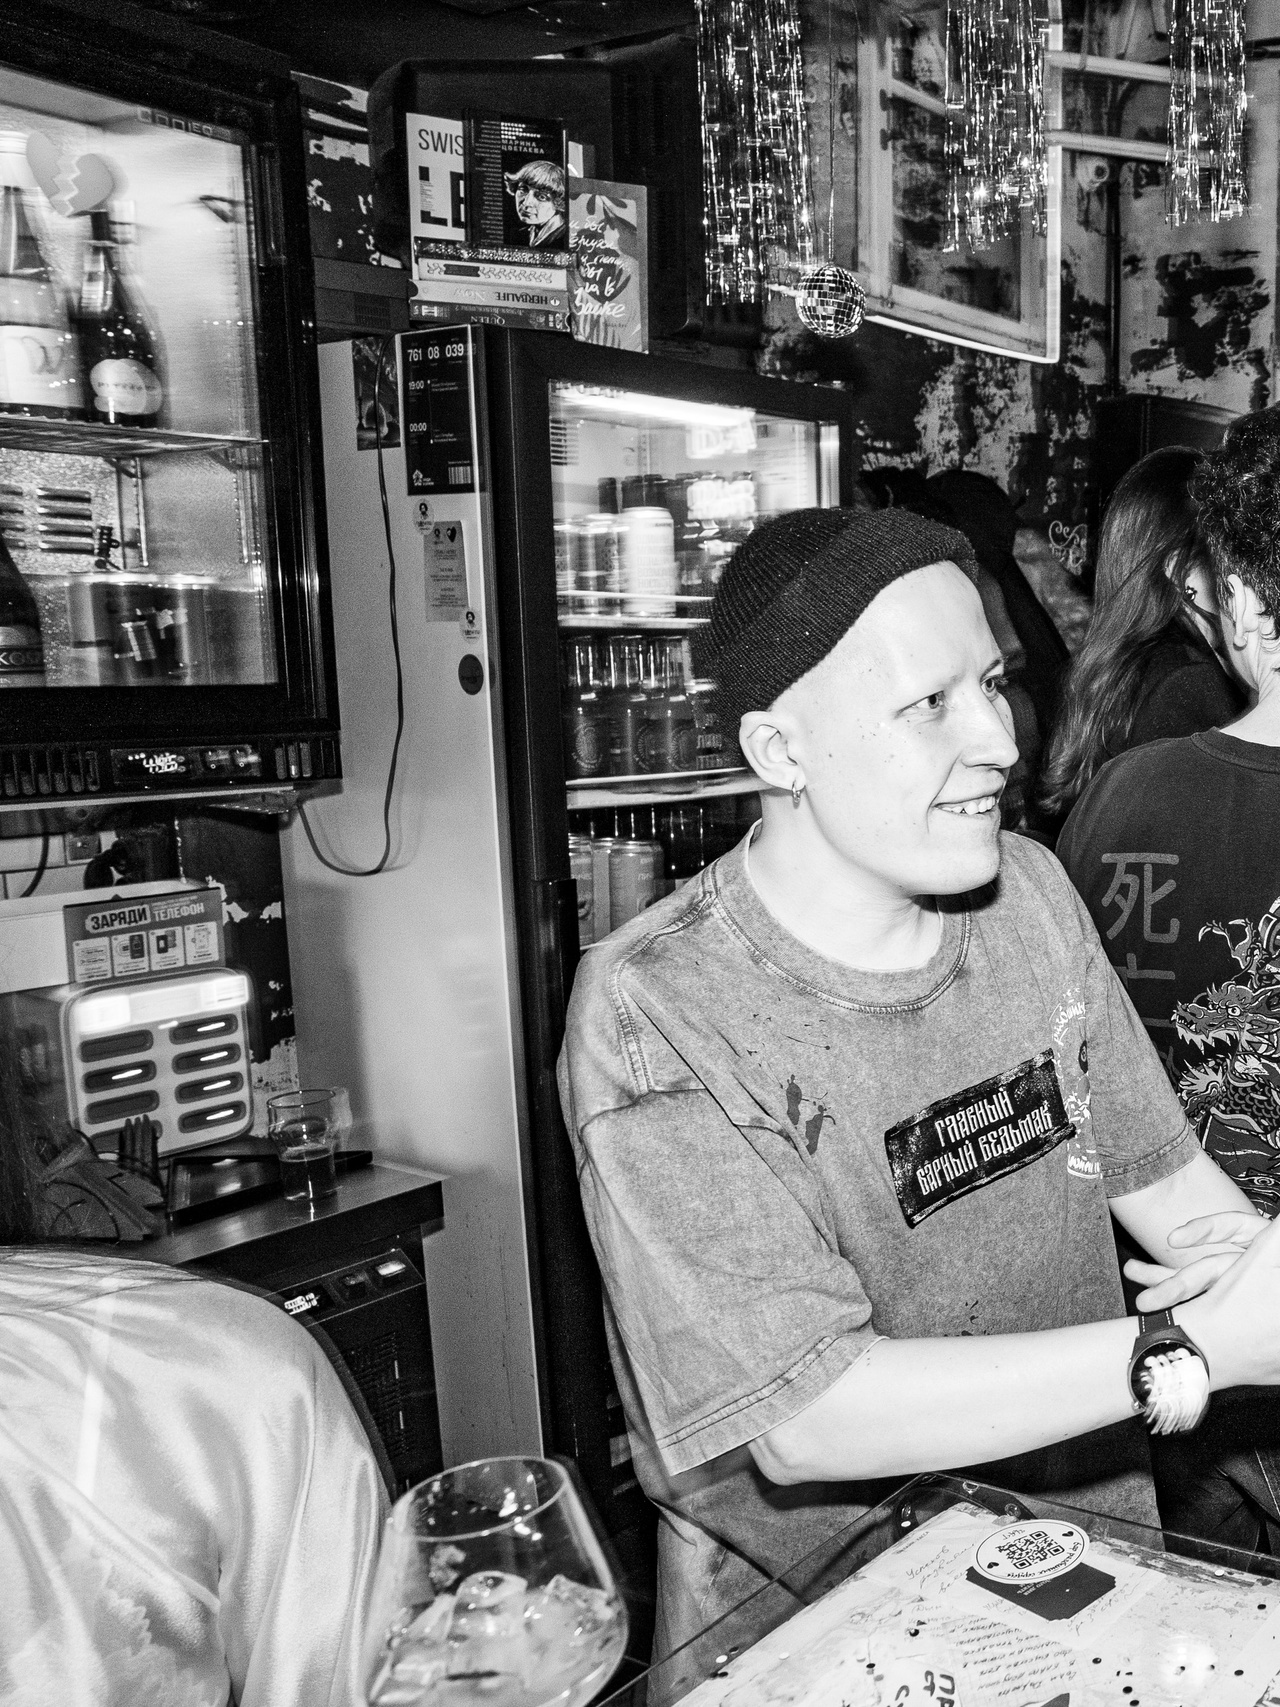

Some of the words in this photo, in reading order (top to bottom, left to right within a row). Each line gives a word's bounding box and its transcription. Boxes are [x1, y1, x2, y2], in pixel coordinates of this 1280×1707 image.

[495, 292, 549, 305] HERBALIFE
[470, 314, 506, 326] QUEEN
[407, 348, 422, 362] 761
[427, 346, 440, 360] 08
[445, 343, 464, 357] 039
[91, 908, 147, 930] ЗАРЯДИ
[153, 903, 205, 922] ТЕЛЕФОН
[935, 1088, 1015, 1147] ГЛАВНЫЙ
